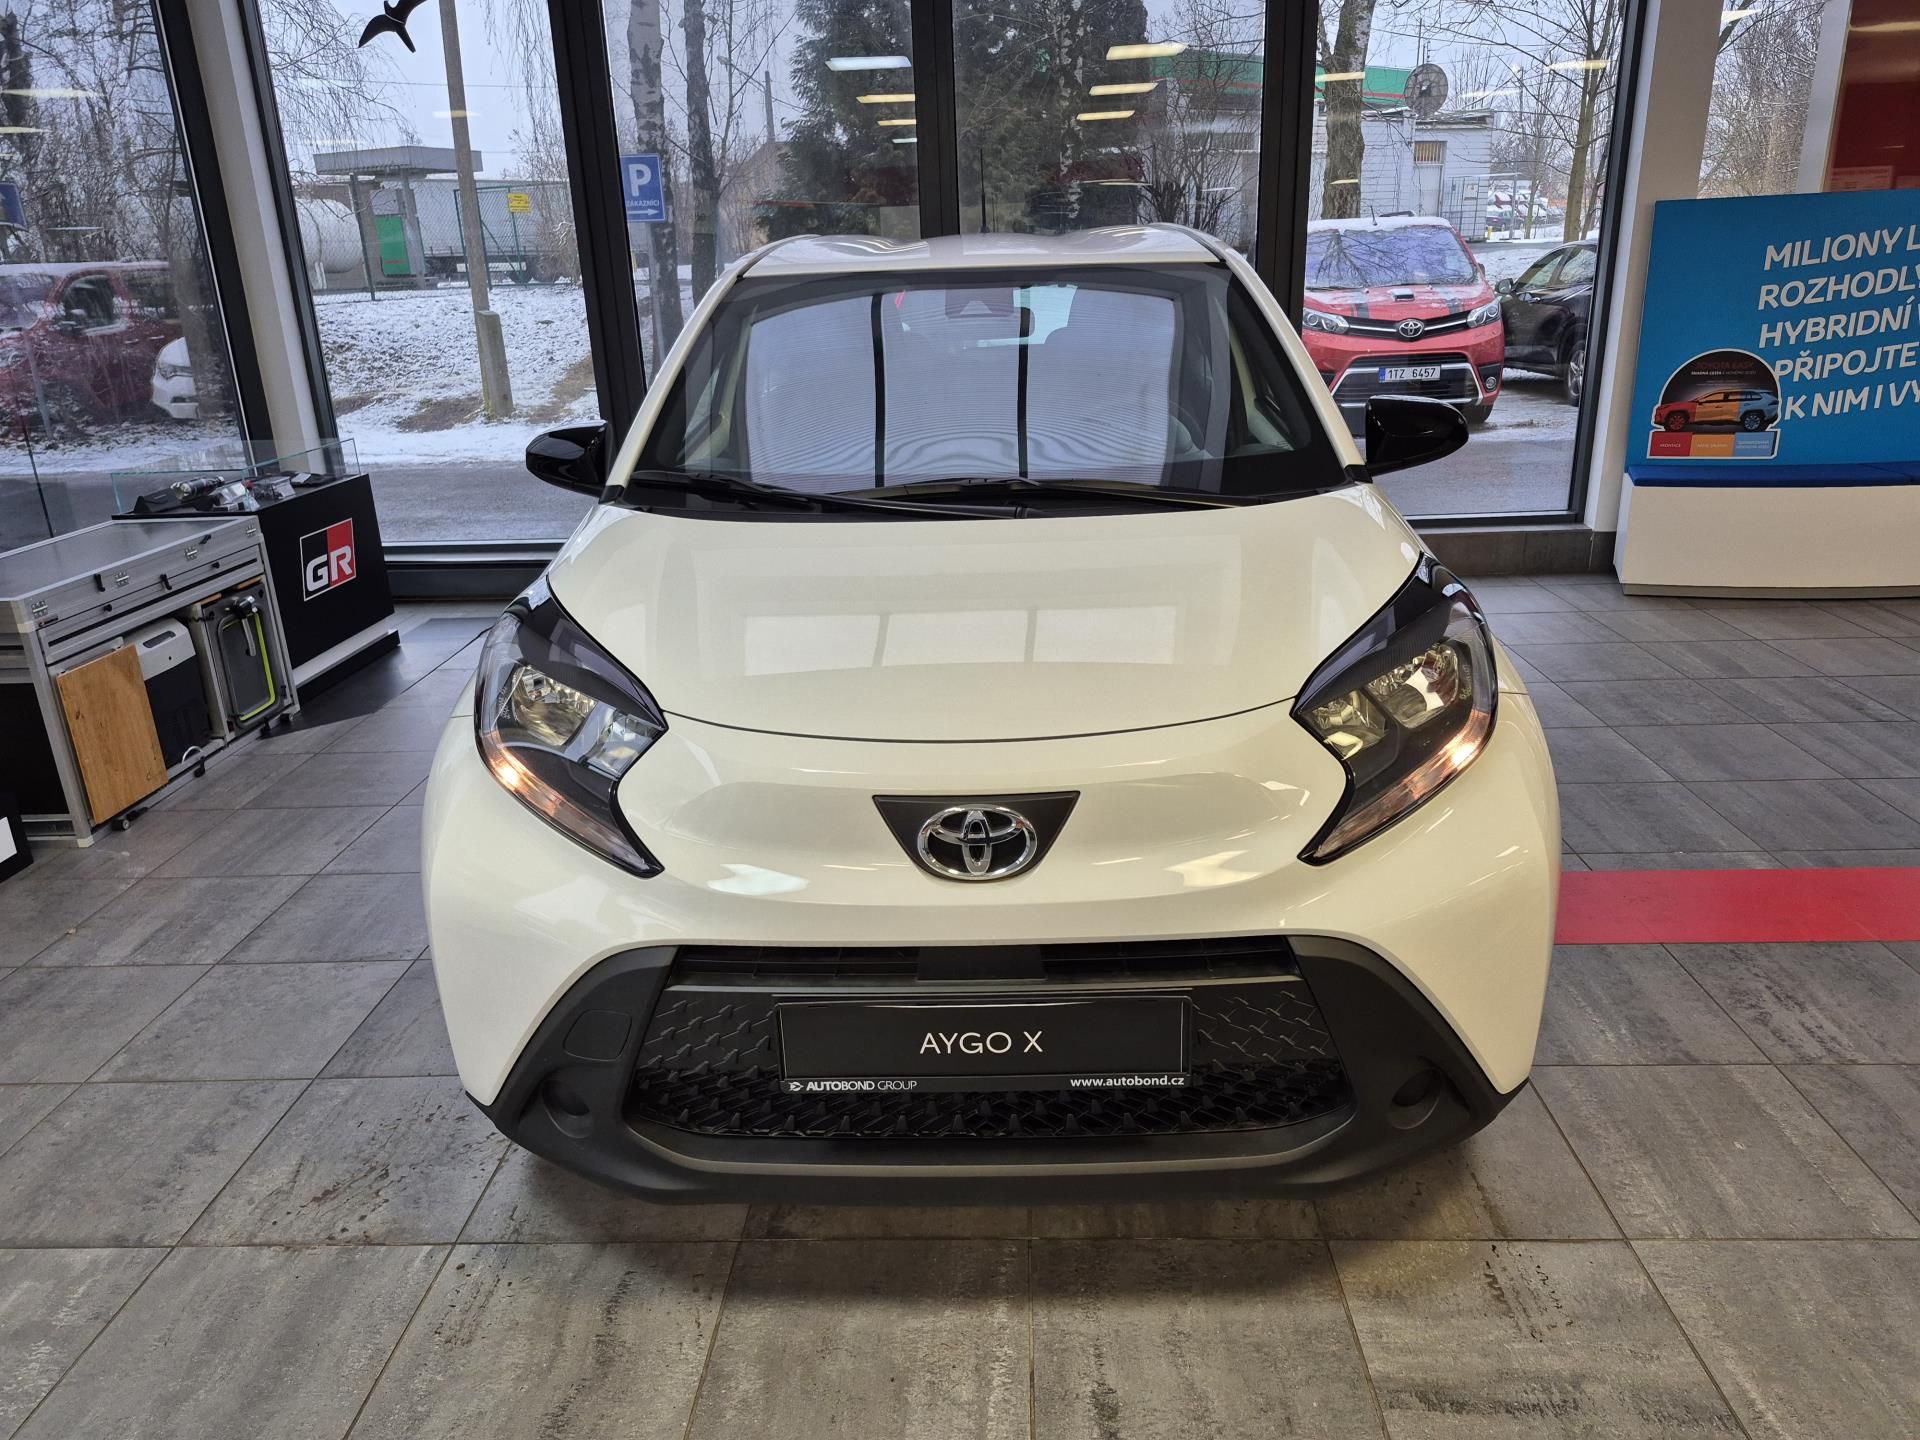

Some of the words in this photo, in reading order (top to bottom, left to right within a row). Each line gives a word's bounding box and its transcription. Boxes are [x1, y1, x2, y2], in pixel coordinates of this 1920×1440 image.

[628, 163, 651, 197] P
[1763, 226, 1904, 271] MILIONY
[1759, 295, 1915, 348] HYBRIDNÍ
[1389, 369, 1406, 379] 1TZ
[1412, 367, 1436, 378] 6457
[1774, 341, 1920, 382] PŘIPOJTE
[1784, 394, 1807, 420] K
[1811, 386, 1870, 417] NIM
[1873, 384, 1884, 409] I
[305, 545, 353, 592] GR
[919, 1031, 1012, 1055] AYGO
[1023, 1030, 1043, 1054] X
[806, 1080, 876, 1092] AUTOBOND
[877, 1080, 918, 1091] GROUP
[1070, 1075, 1185, 1087] www.autobond.cz
